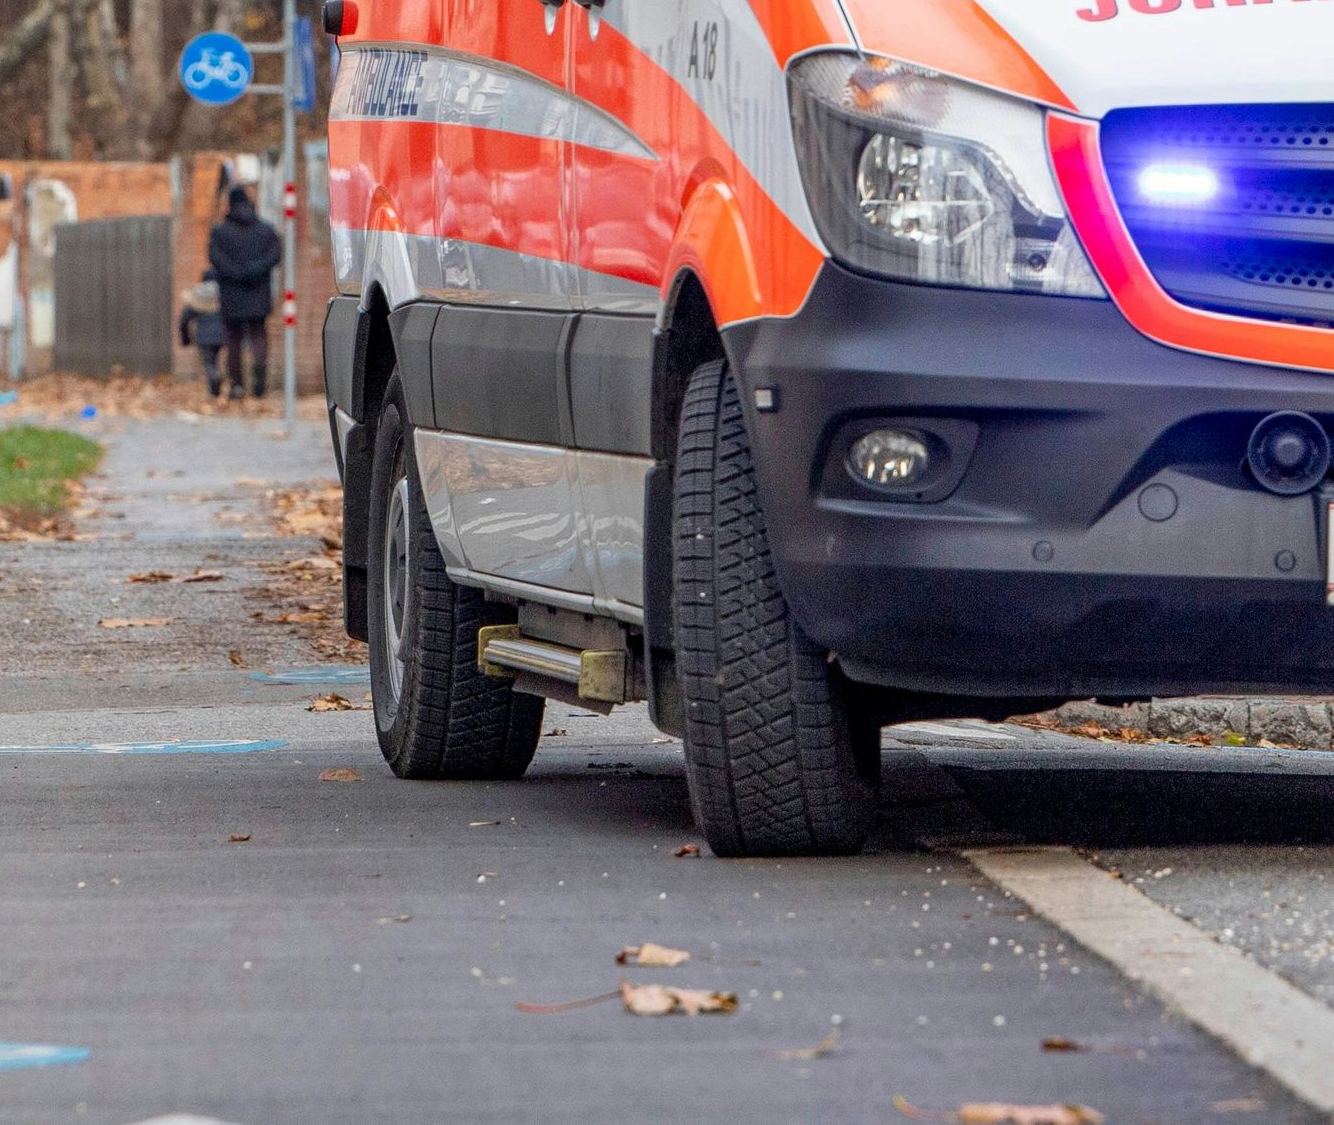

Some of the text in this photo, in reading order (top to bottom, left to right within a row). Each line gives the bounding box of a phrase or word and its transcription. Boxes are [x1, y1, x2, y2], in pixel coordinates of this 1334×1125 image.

[347, 47, 428, 116] AMBULANCE
[687, 21, 718, 81] A 18
